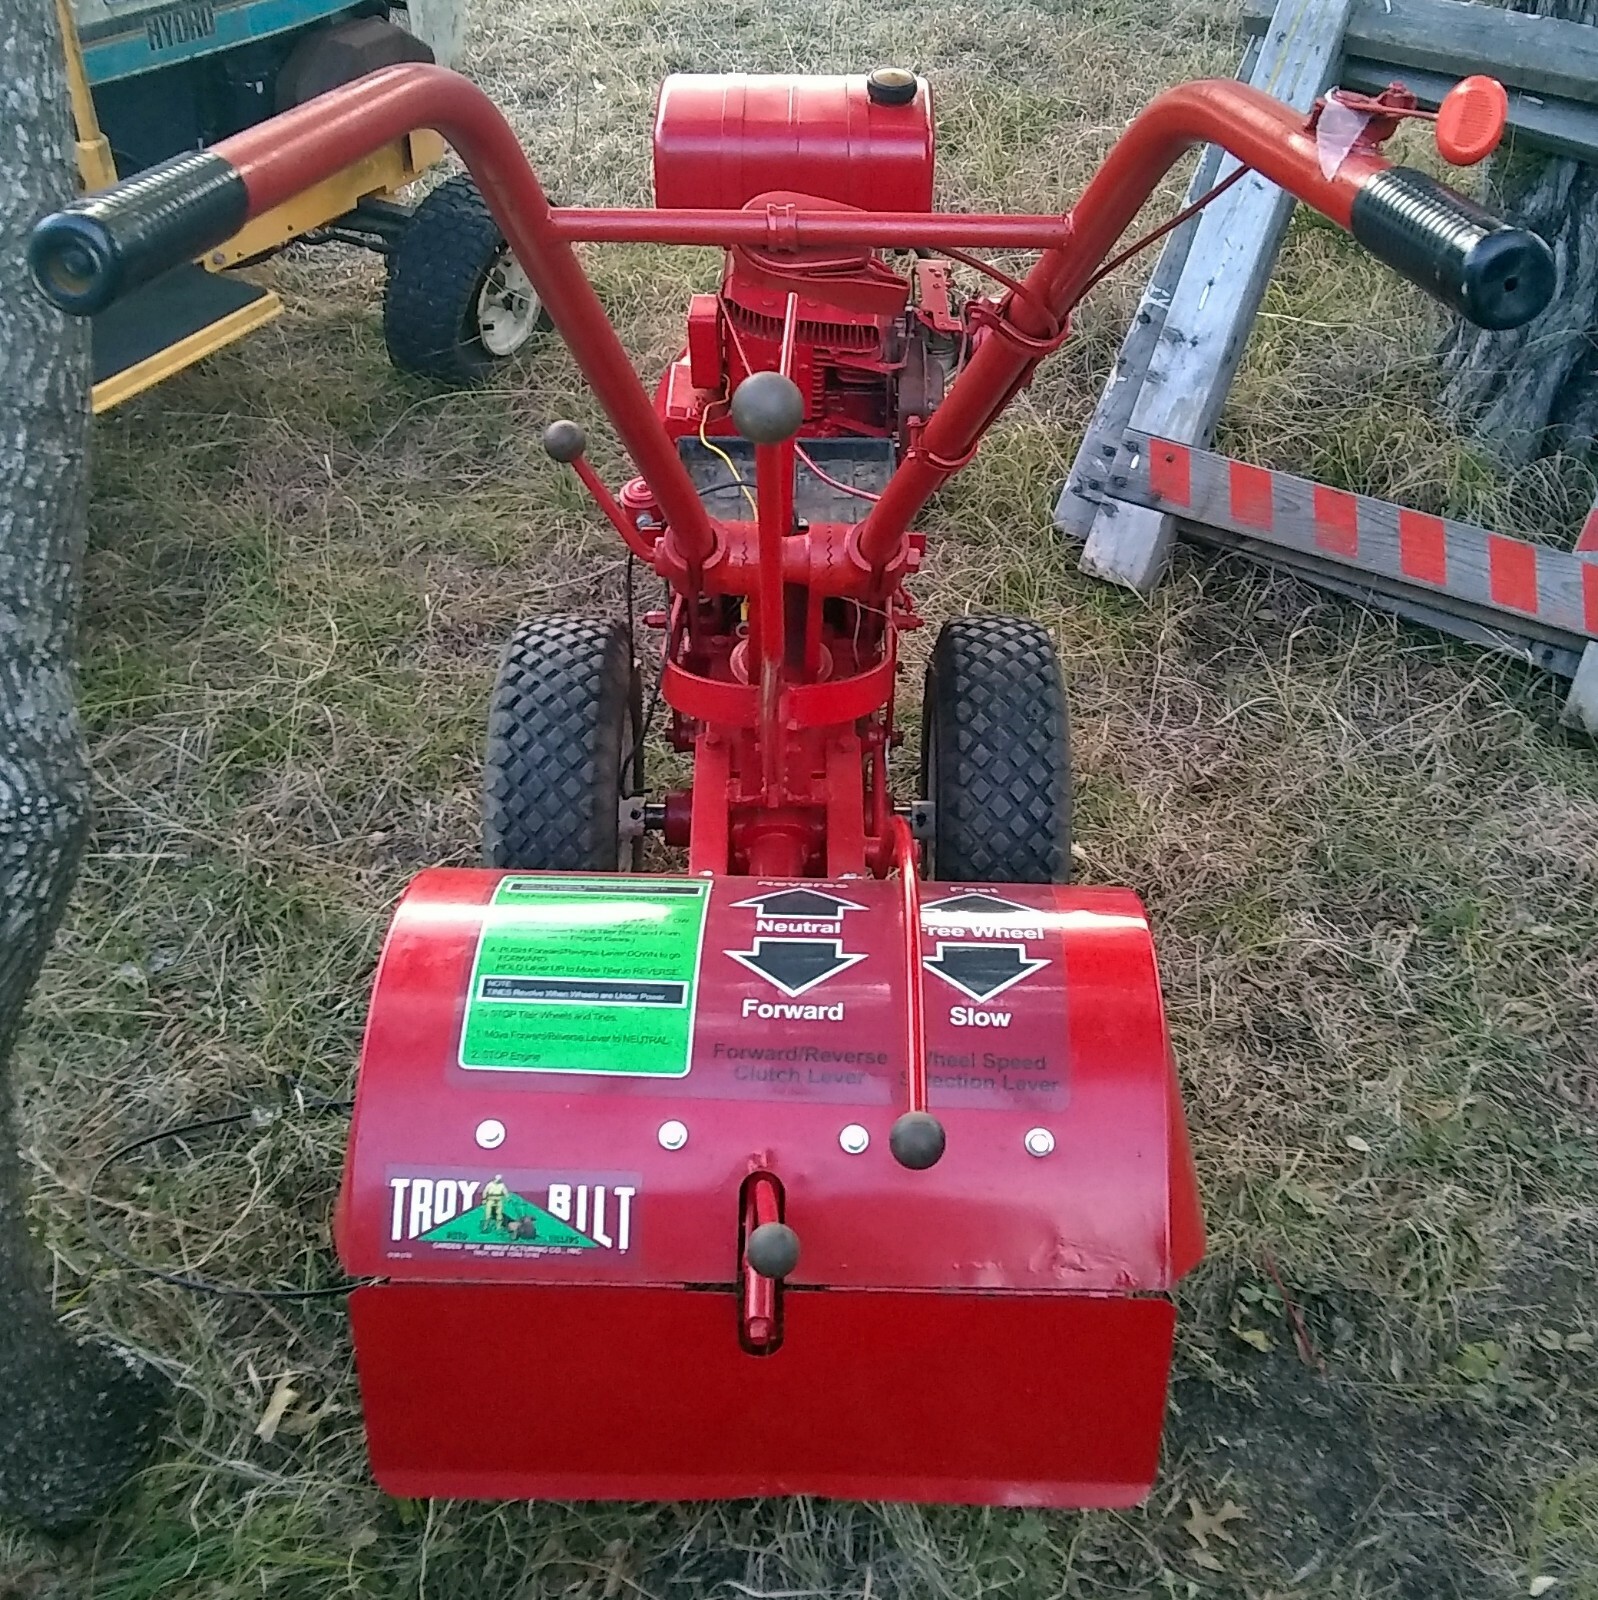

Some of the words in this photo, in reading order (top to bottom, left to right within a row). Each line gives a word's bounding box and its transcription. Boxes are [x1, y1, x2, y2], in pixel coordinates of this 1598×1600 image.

[145, 3, 216, 51] HYDRO
[757, 880, 849, 889] Reverse
[756, 919, 842, 934] Neutral
[971, 926, 1045, 940] Wheel
[742, 999, 844, 1021] Forward
[949, 1006, 1012, 1027] Slow
[713, 1043, 888, 1065] Forward/Reverse
[982, 1052, 1046, 1072] Speed
[734, 1064, 801, 1081] Clutch
[808, 1067, 864, 1084] Lever
[1002, 1074, 1058, 1093] Lever
[390, 1178, 480, 1241] TROY
[548, 1183, 636, 1251] BILT
